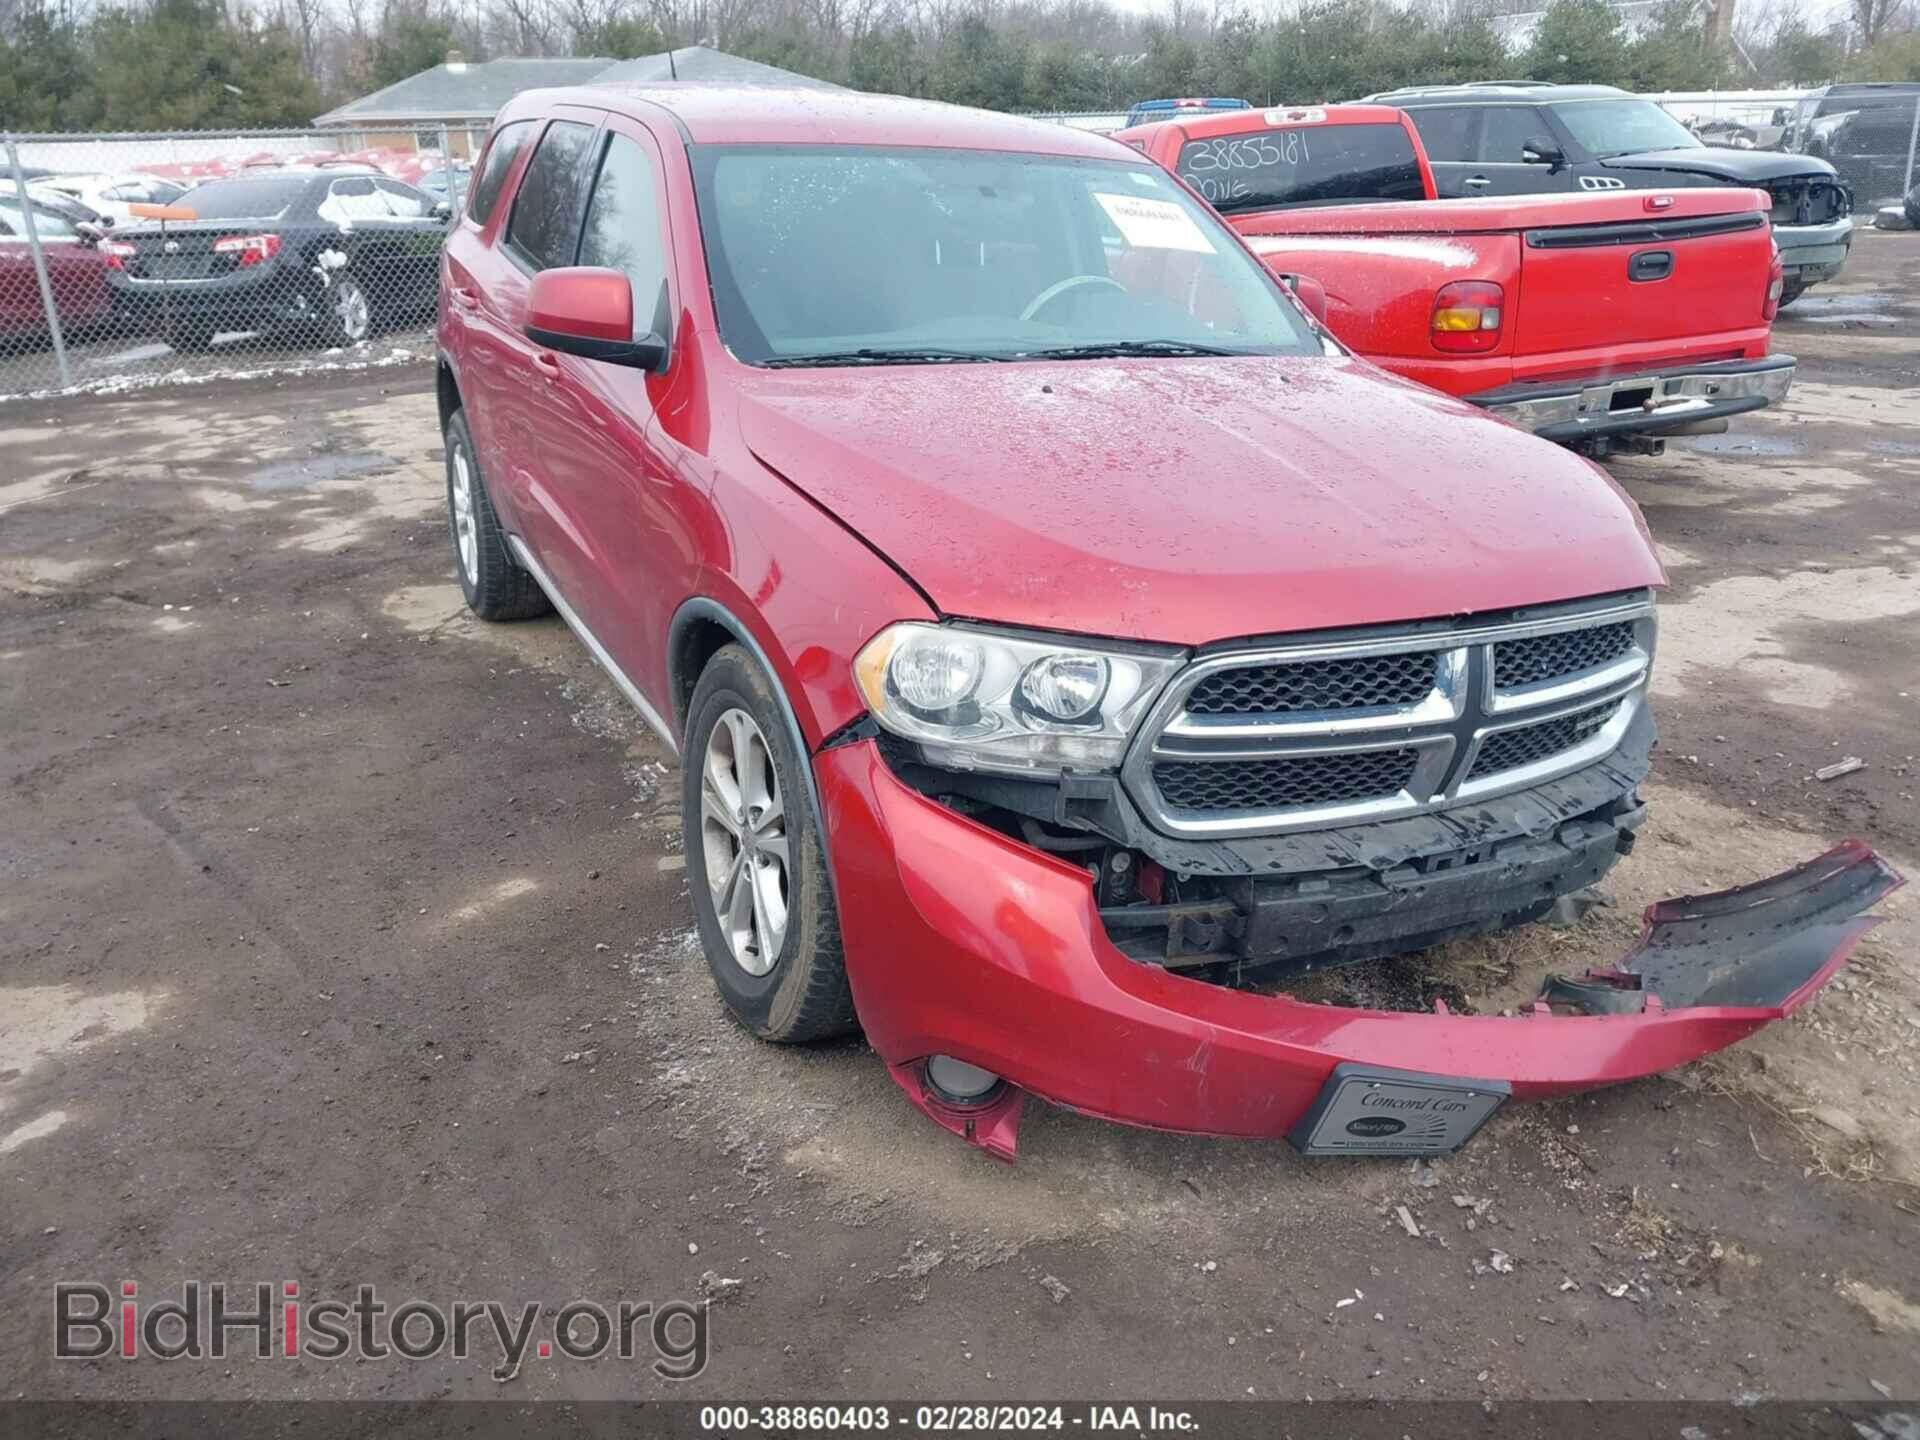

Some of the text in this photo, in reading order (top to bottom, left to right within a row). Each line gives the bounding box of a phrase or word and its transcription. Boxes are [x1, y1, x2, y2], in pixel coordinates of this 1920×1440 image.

[1187, 131, 1310, 170] 38855181
[1361, 1092, 1469, 1113] Concord Cars
